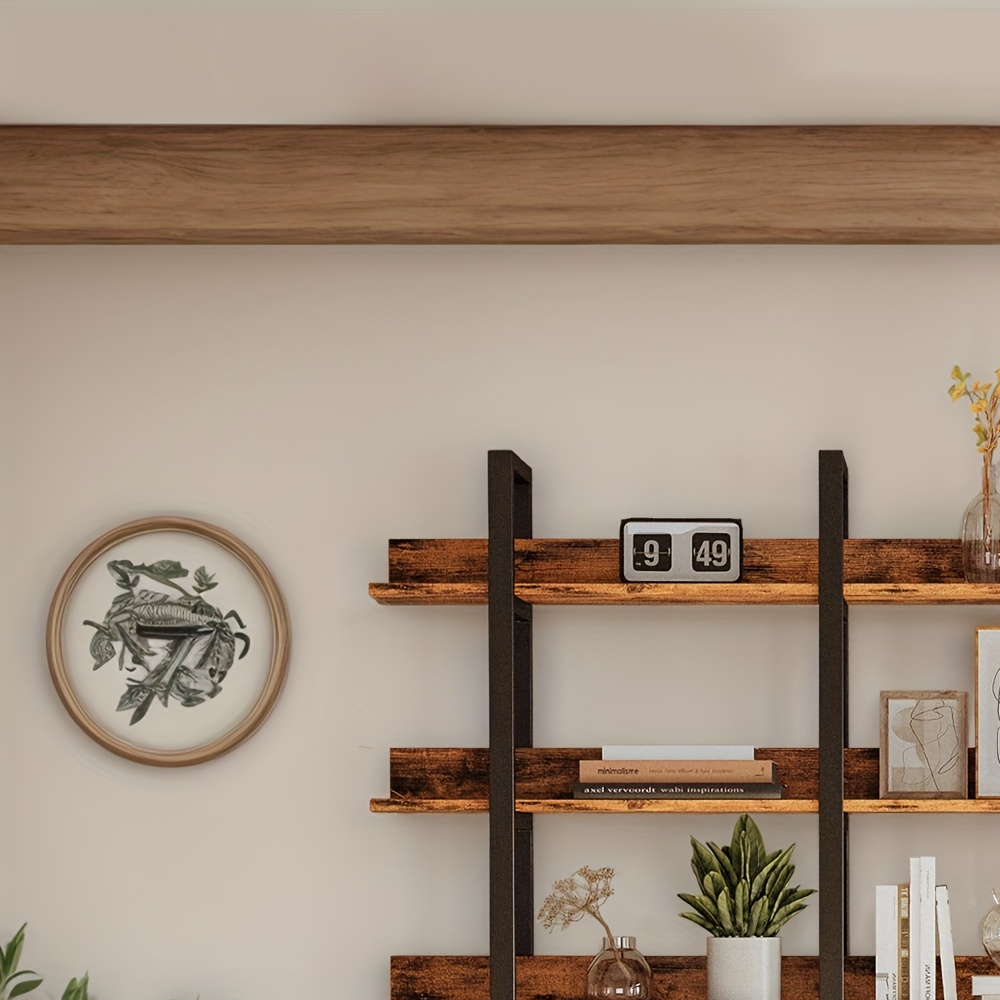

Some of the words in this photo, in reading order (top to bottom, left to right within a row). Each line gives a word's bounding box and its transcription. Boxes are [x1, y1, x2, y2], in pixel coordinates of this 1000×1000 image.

[643, 539, 660, 567] 9
[695, 539, 728, 567] 49
[597, 767, 640, 775] minimalisme
[583, 786, 605, 794] axel
[607, 786, 656, 794] vervoordt
[660, 786, 684, 794] wabi
[687, 786, 745, 794] inspirations
